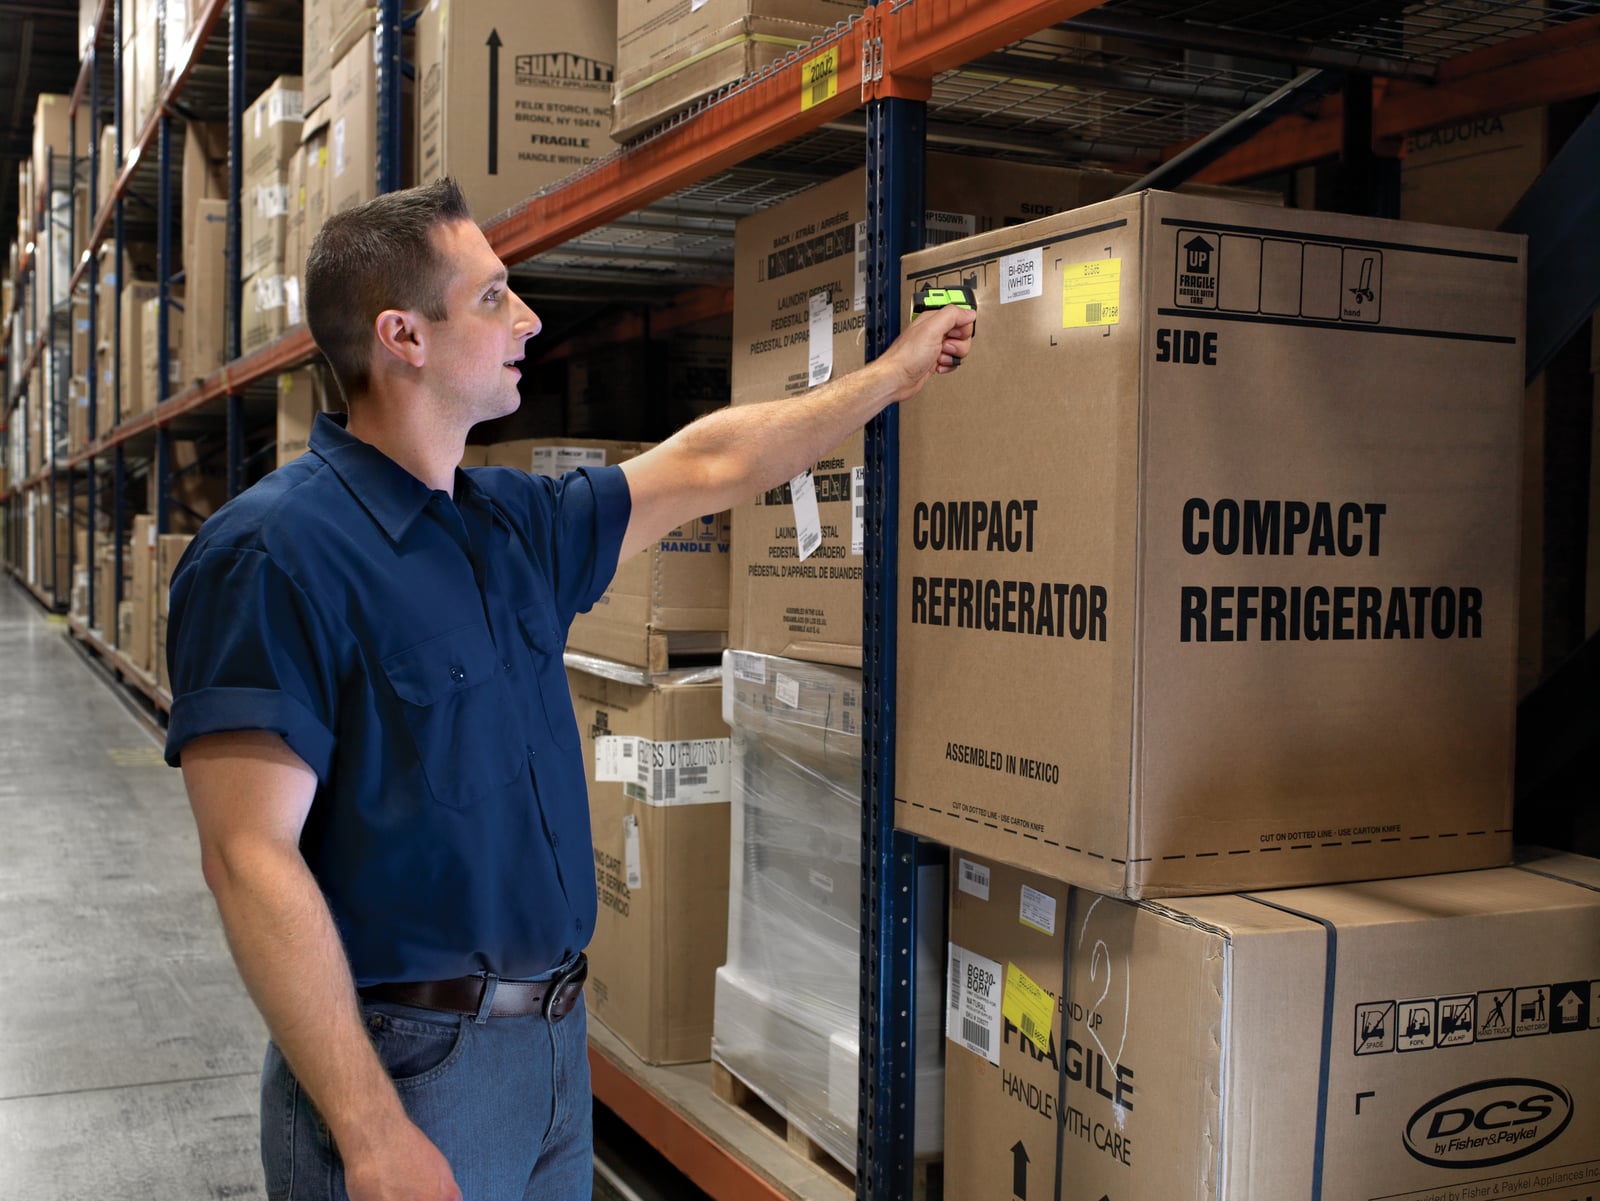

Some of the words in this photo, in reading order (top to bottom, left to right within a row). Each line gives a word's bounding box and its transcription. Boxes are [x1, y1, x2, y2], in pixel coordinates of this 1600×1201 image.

[516, 52, 613, 81] SUMMIT
[515, 100, 544, 110] FELIX
[557, 117, 571, 125] NY
[531, 134, 590, 148] FRAGILE
[1407, 116, 1504, 152] ECADORA
[518, 152, 555, 163] HANDLE
[558, 154, 581, 164] WITH
[1021, 203, 1054, 215] SIDE
[1189, 251, 1207, 267] UP
[1007, 274, 1035, 291] (WHITE)
[1180, 274, 1215, 289] FRAGILE
[778, 291, 807, 311] LAUNDRY
[771, 312, 802, 331] PEDESTAL
[1343, 308, 1361, 317] hand
[784, 329, 809, 347] D'APPAR
[1156, 328, 1218, 365] SIDE
[775, 527, 798, 539] LAUND
[913, 499, 1038, 552] COMPACT
[1182, 497, 1386, 557] COMPACT
[661, 542, 712, 552] HANDLE
[768, 546, 800, 558] PEDESTAL
[819, 567, 829, 578] DE
[830, 567, 863, 580] BUANDER
[911, 576, 1108, 641] REFRIGERATOR
[1180, 585, 1483, 642] REFRIGERATOR
[945, 742, 1002, 771] ASSEMBLED
[1006, 754, 1016, 775] IN
[1020, 757, 1059, 784] MEXICO
[952, 801, 961, 809] CUT
[962, 804, 968, 812] ON
[968, 805, 986, 817] DOTTED
[987, 811, 997, 820] LINE
[1001, 814, 1010, 822] USE
[1011, 816, 1029, 829] CARTON
[1030, 822, 1044, 833] KNIFE
[1260, 834, 1275, 842] CUT
[1276, 833, 1287, 841] ON
[1288, 831, 1316, 841] DOTTED
[1317, 829, 1332, 838] LINE
[1338, 828, 1352, 837] USE
[1353, 825, 1381, 835] CARTON
[1381, 824, 1400, 833] KNIFE
[968, 963, 996, 986] BGB30-
[1058, 996, 1083, 1022] END
[1087, 1008, 1103, 1030] UP
[1366, 1040, 1384, 1049] SPADE
[1447, 1034, 1466, 1042] CLAMP
[1002, 1068, 1052, 1120] HANDLE
[1053, 1097, 1091, 1142] WITH
[1093, 1123, 1132, 1167] CARE
[1426, 1094, 1554, 1139] DCS
[1434, 1143, 1446, 1156] by
[1462, 1185, 1490, 1199] Fisher
[1493, 1184, 1499, 1193] &
[1502, 1176, 1531, 1193] Paykel
[1533, 1170, 1584, 1187] Appliances
